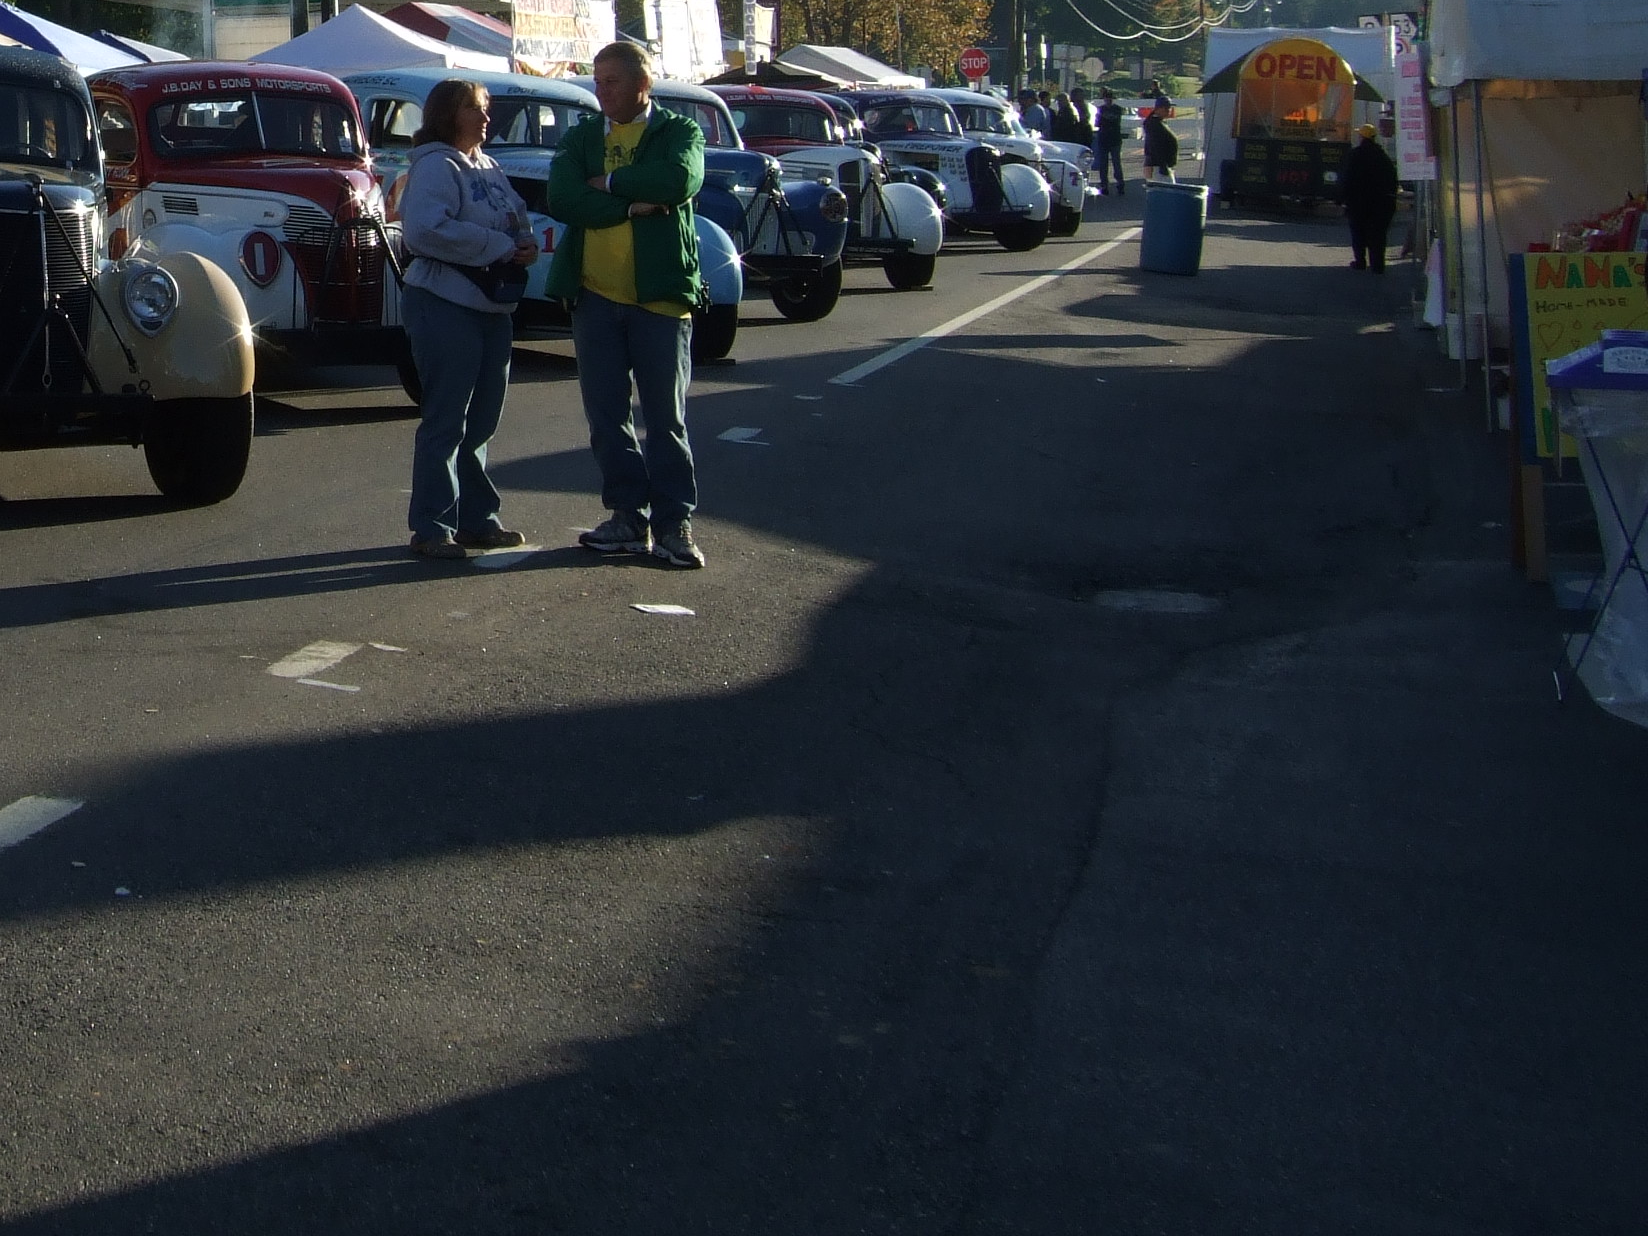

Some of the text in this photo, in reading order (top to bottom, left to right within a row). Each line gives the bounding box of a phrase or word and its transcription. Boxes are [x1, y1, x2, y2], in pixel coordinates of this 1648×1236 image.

[1393, 19, 1411, 35] 53
[961, 57, 988, 71] STOP
[1255, 52, 1337, 81] OPEN
[208, 79, 216, 90] &
[220, 78, 251, 90] SONS
[256, 78, 332, 94] MOTORSPORTS
